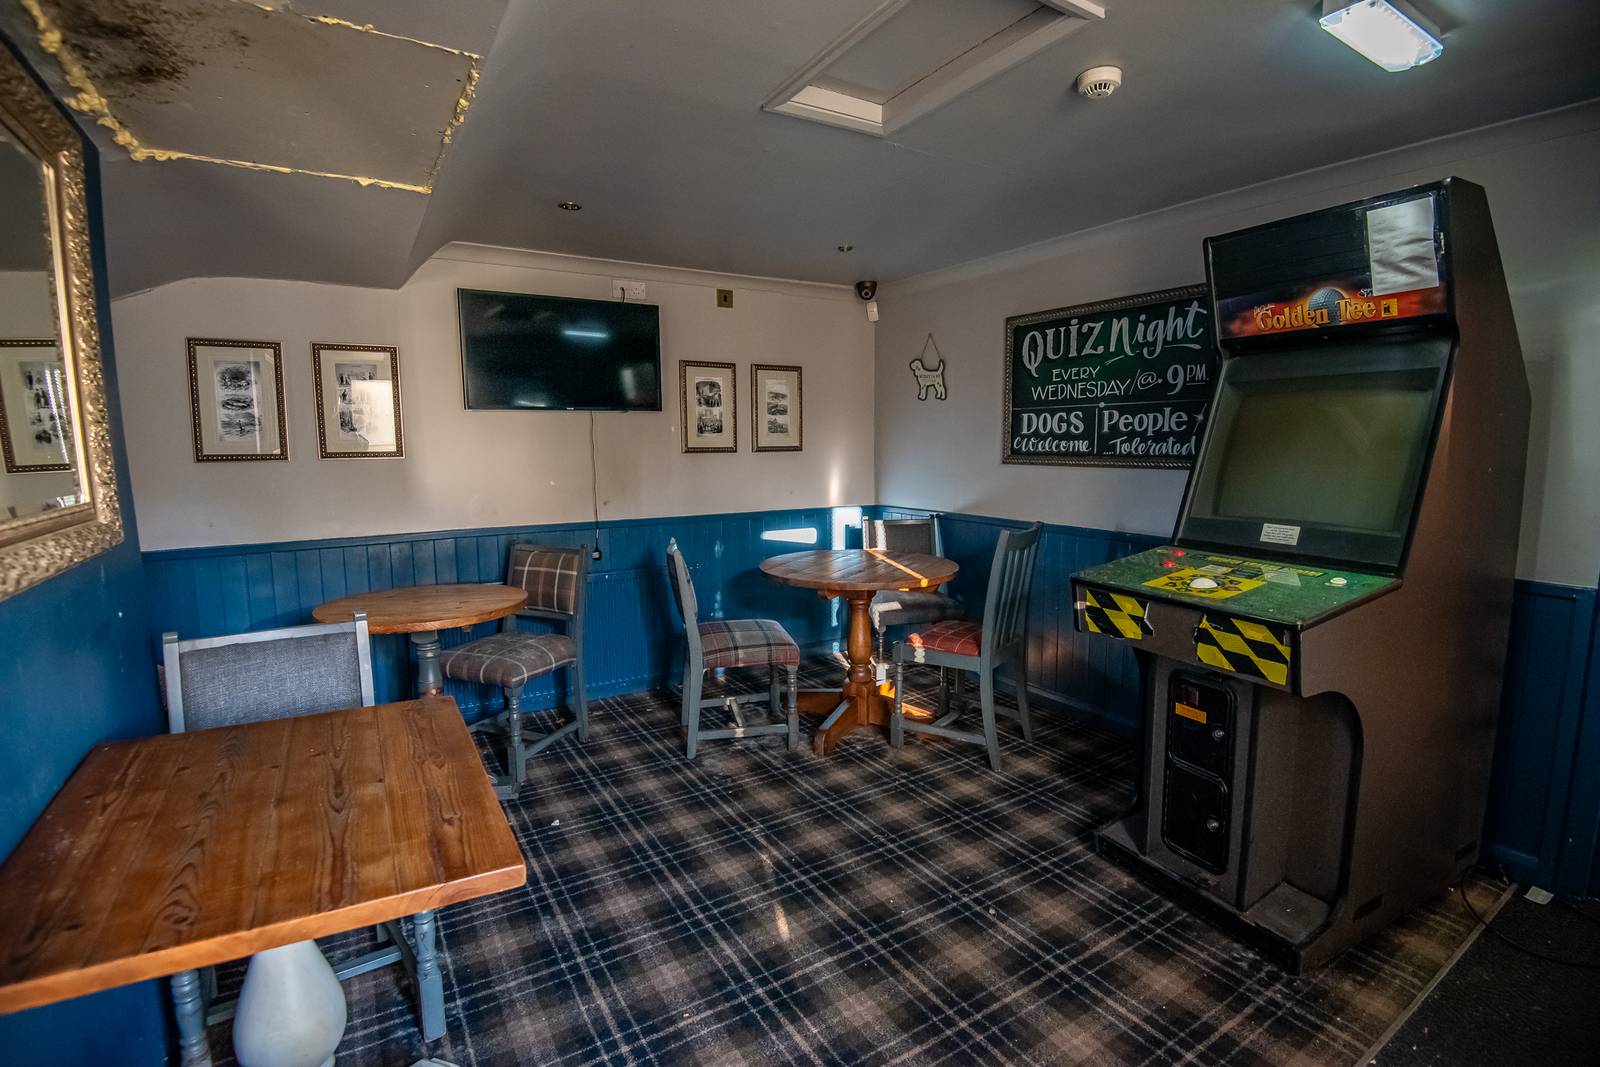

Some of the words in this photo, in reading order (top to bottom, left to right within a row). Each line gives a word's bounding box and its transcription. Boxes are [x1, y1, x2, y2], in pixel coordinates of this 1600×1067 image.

[1109, 300, 1207, 359] Night
[1255, 304, 1330, 332] Golden
[1334, 298, 1377, 322] Tee
[1052, 366, 1100, 382] EVERY
[1021, 411, 1085, 434] DOGS
[1102, 407, 1188, 436] People
